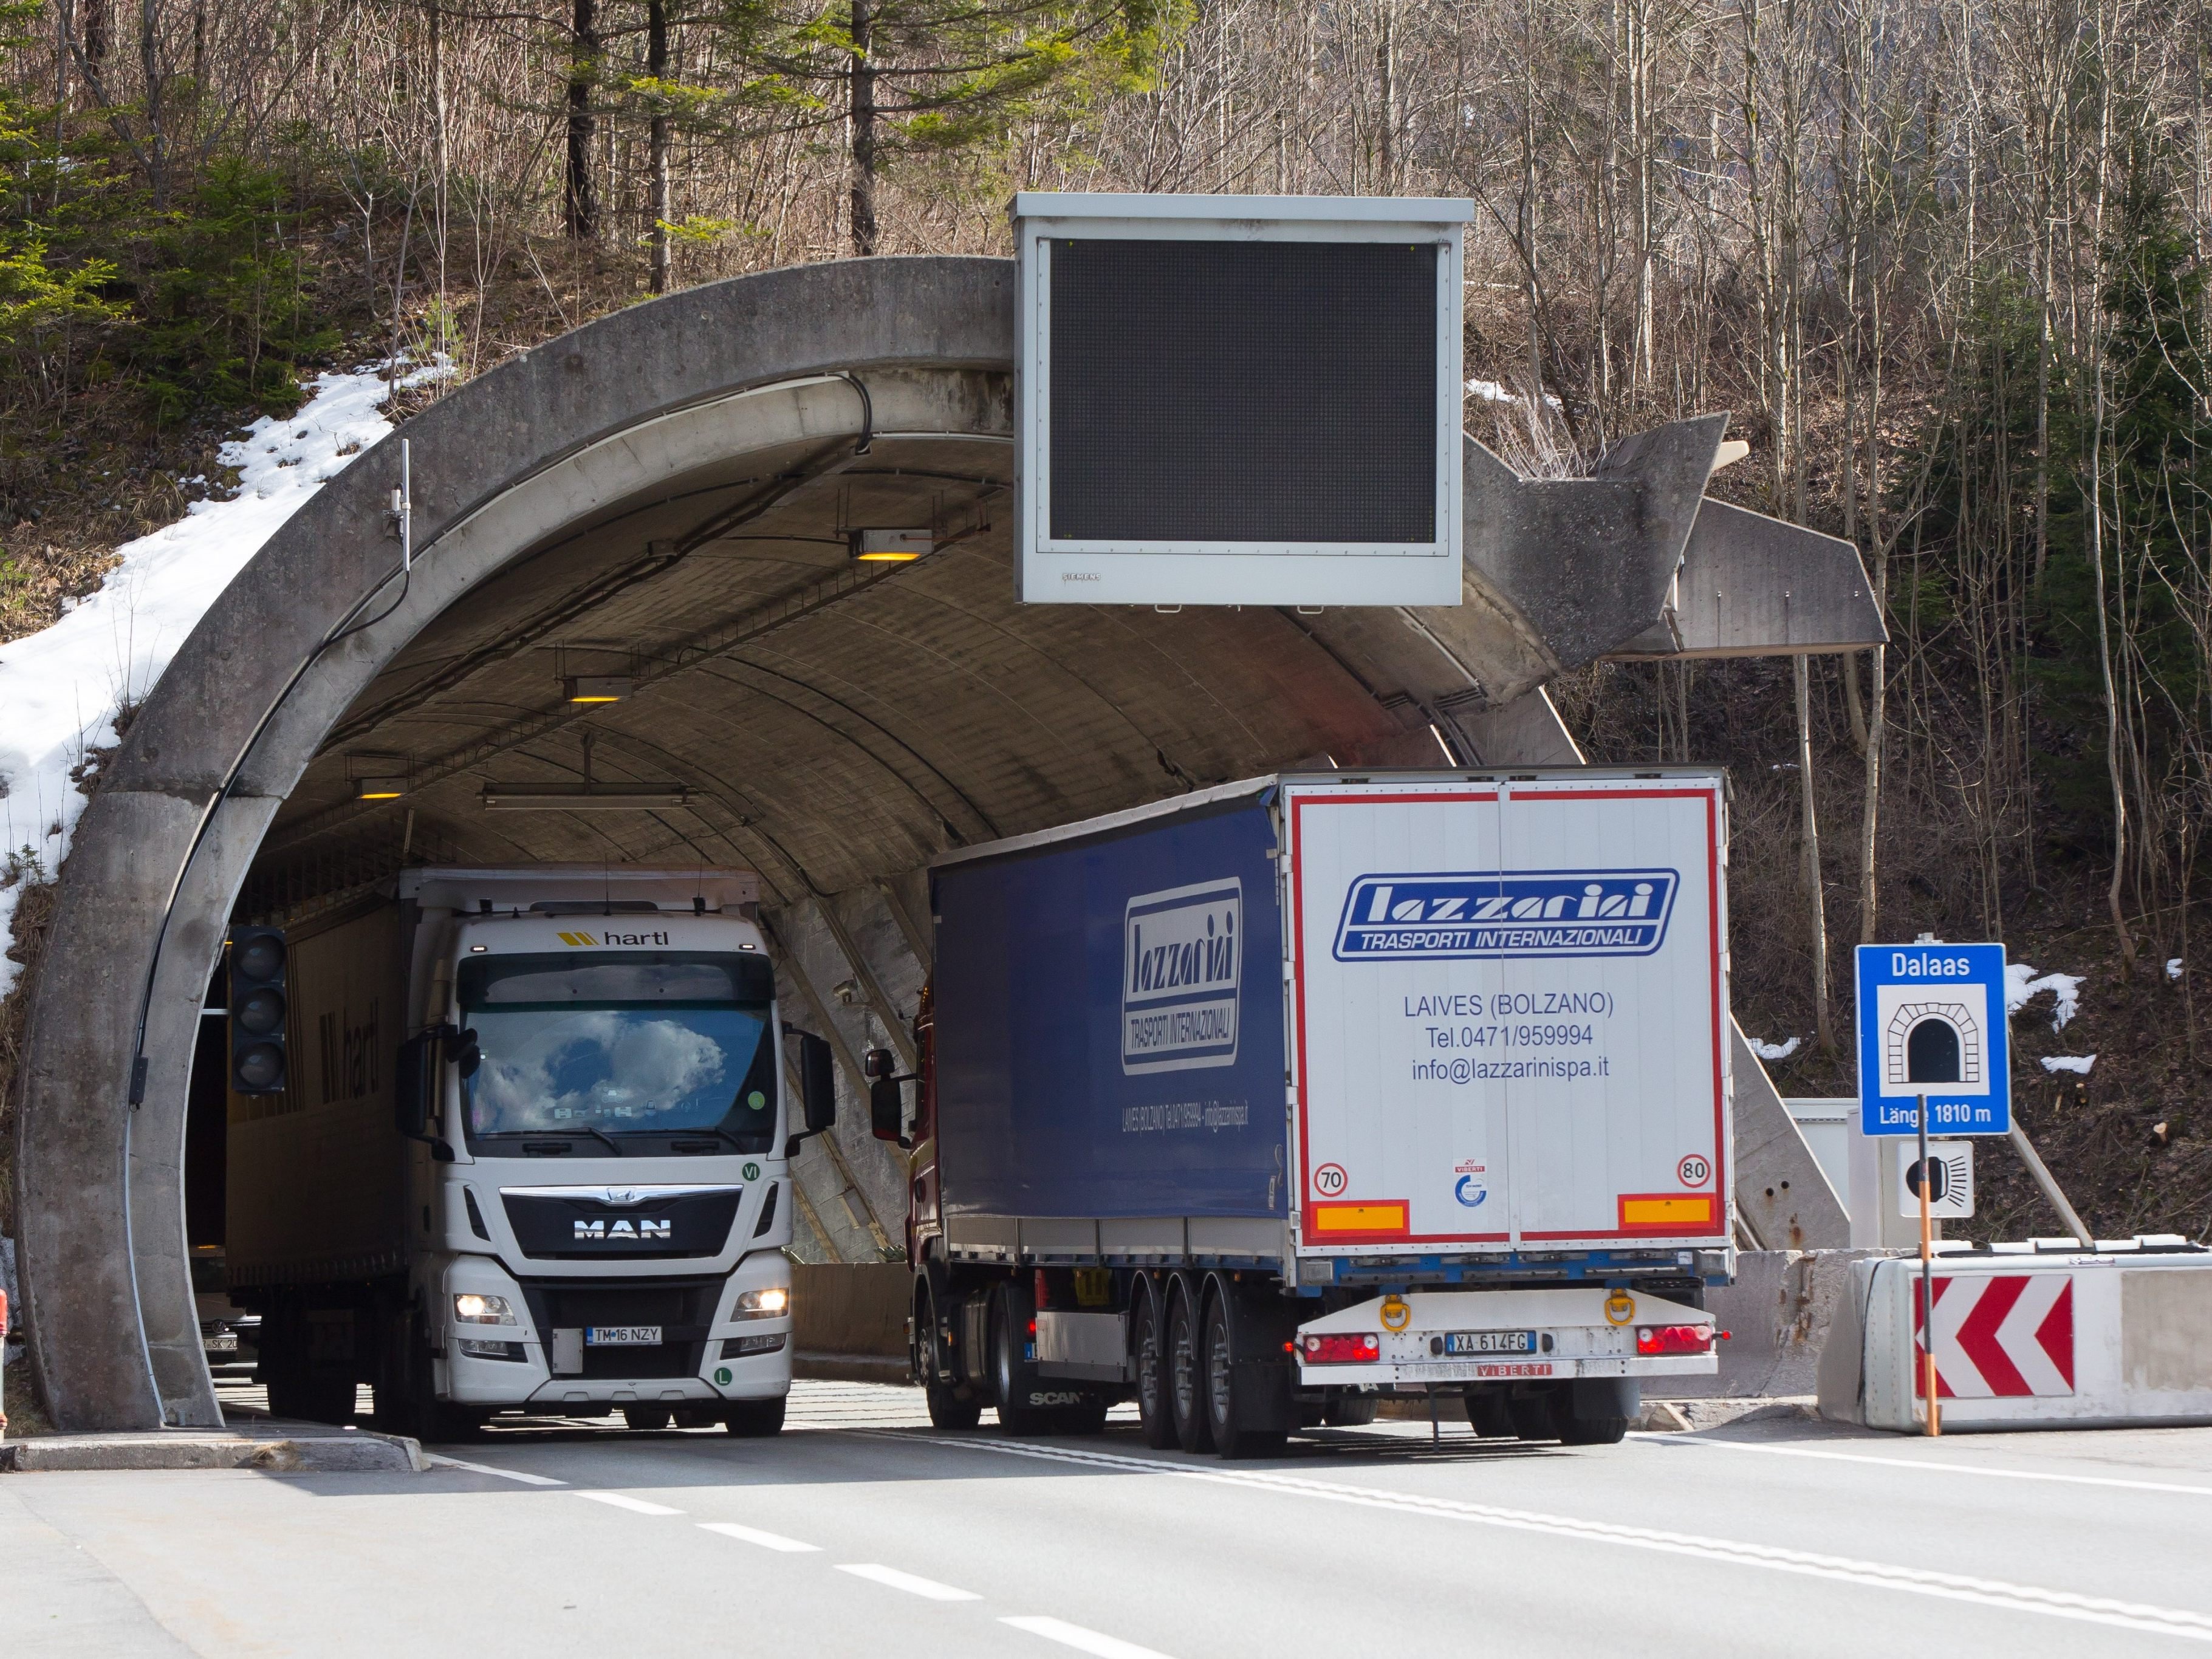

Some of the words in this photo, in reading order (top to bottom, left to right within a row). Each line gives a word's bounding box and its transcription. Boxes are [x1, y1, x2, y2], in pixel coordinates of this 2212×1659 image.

[604, 931, 669, 945] hartl
[1361, 932, 1470, 949] TRASPORTI
[1474, 928, 1642, 948] INTERNAZIONALI
[1892, 953, 1970, 976] Dalaas
[1405, 994, 1483, 1018] LAIVES
[1490, 992, 1614, 1021] (BOLZANO)
[1131, 1014, 1168, 1049] TRASPORTI
[1169, 1007, 1230, 1044] INTERNAZIONALI
[1426, 1024, 1593, 1048] Tel.0471/959994
[1412, 1055, 1609, 1085] info@lazzarinispa.it
[1935, 1104, 1971, 1123] 1810
[1976, 1107, 1991, 1123] m
[744, 1166, 758, 1179] VI
[1683, 1162, 1705, 1178] 80
[1321, 1172, 1341, 1188] 70
[574, 1220, 671, 1239] MAN
[595, 1329, 611, 1341] TM
[616, 1329, 628, 1341] 16
[631, 1328, 658, 1341] NZY
[1456, 1335, 1474, 1350] XA
[1480, 1333, 1525, 1350] 614FG
[213, 1339, 224, 1348] SK
[720, 1369, 727, 1384] L
[1481, 1365, 1548, 1376] VIBERTI
[1029, 1392, 1094, 1406] SCAN
